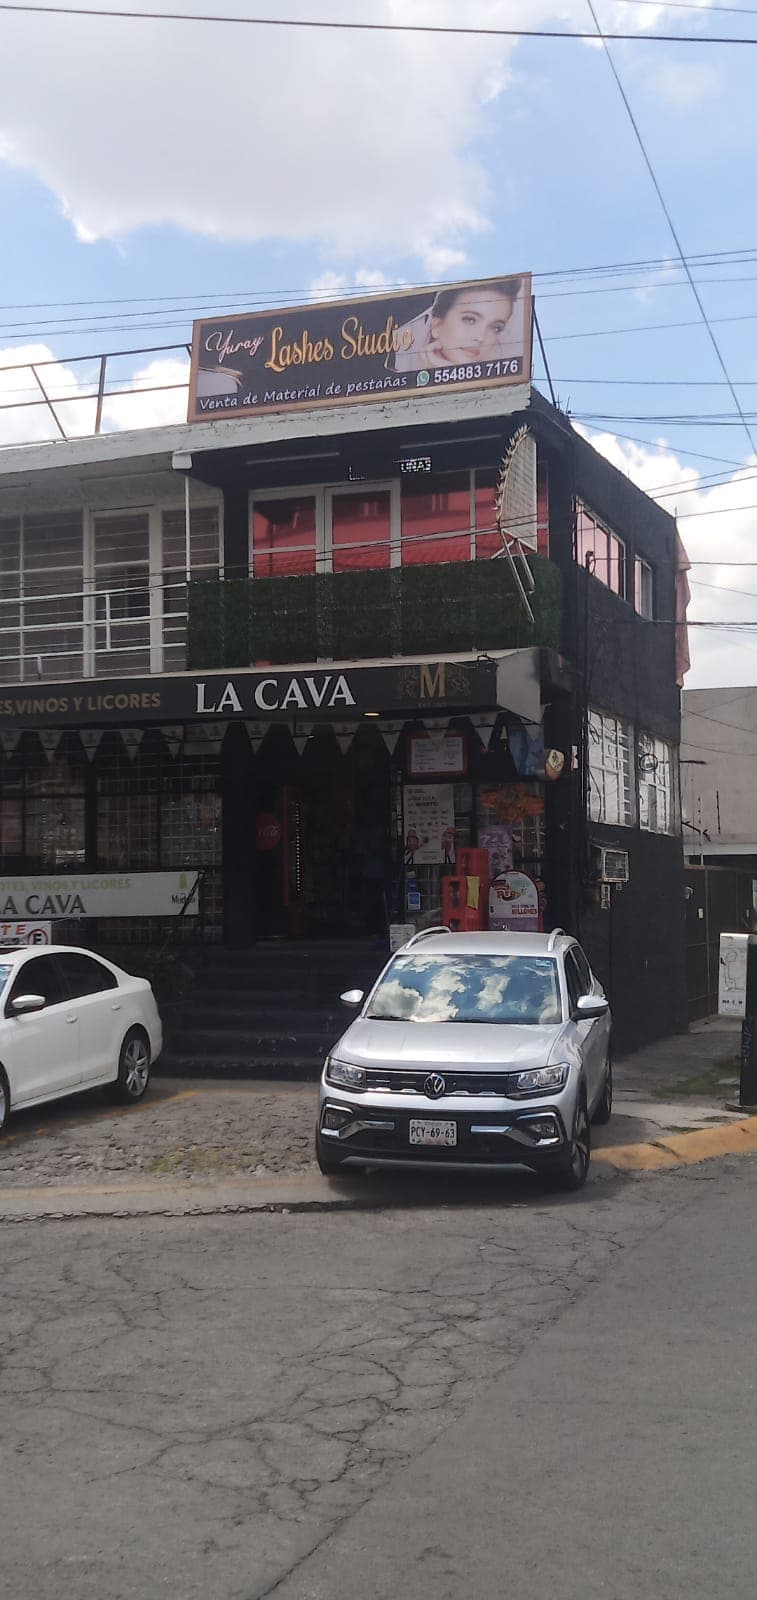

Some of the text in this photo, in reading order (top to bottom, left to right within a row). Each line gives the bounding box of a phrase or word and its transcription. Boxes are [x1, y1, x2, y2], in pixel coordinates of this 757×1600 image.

[205, 315, 414, 373] Yuray Lashes Studio
[433, 360, 519, 384] 554883 7176
[200, 376, 407, 411] Venta de Material de pestañas
[419, 663, 446, 698] M
[74, 697, 83, 711] Y
[88, 692, 161, 710] LICORES
[195, 674, 356, 713] LA CAVA
[31, 881, 67, 890] VINOS
[81, 878, 132, 889] LICORES
[25, 894, 86, 914] CAVA
[411, 1126, 455, 1139] PCY-69-63
